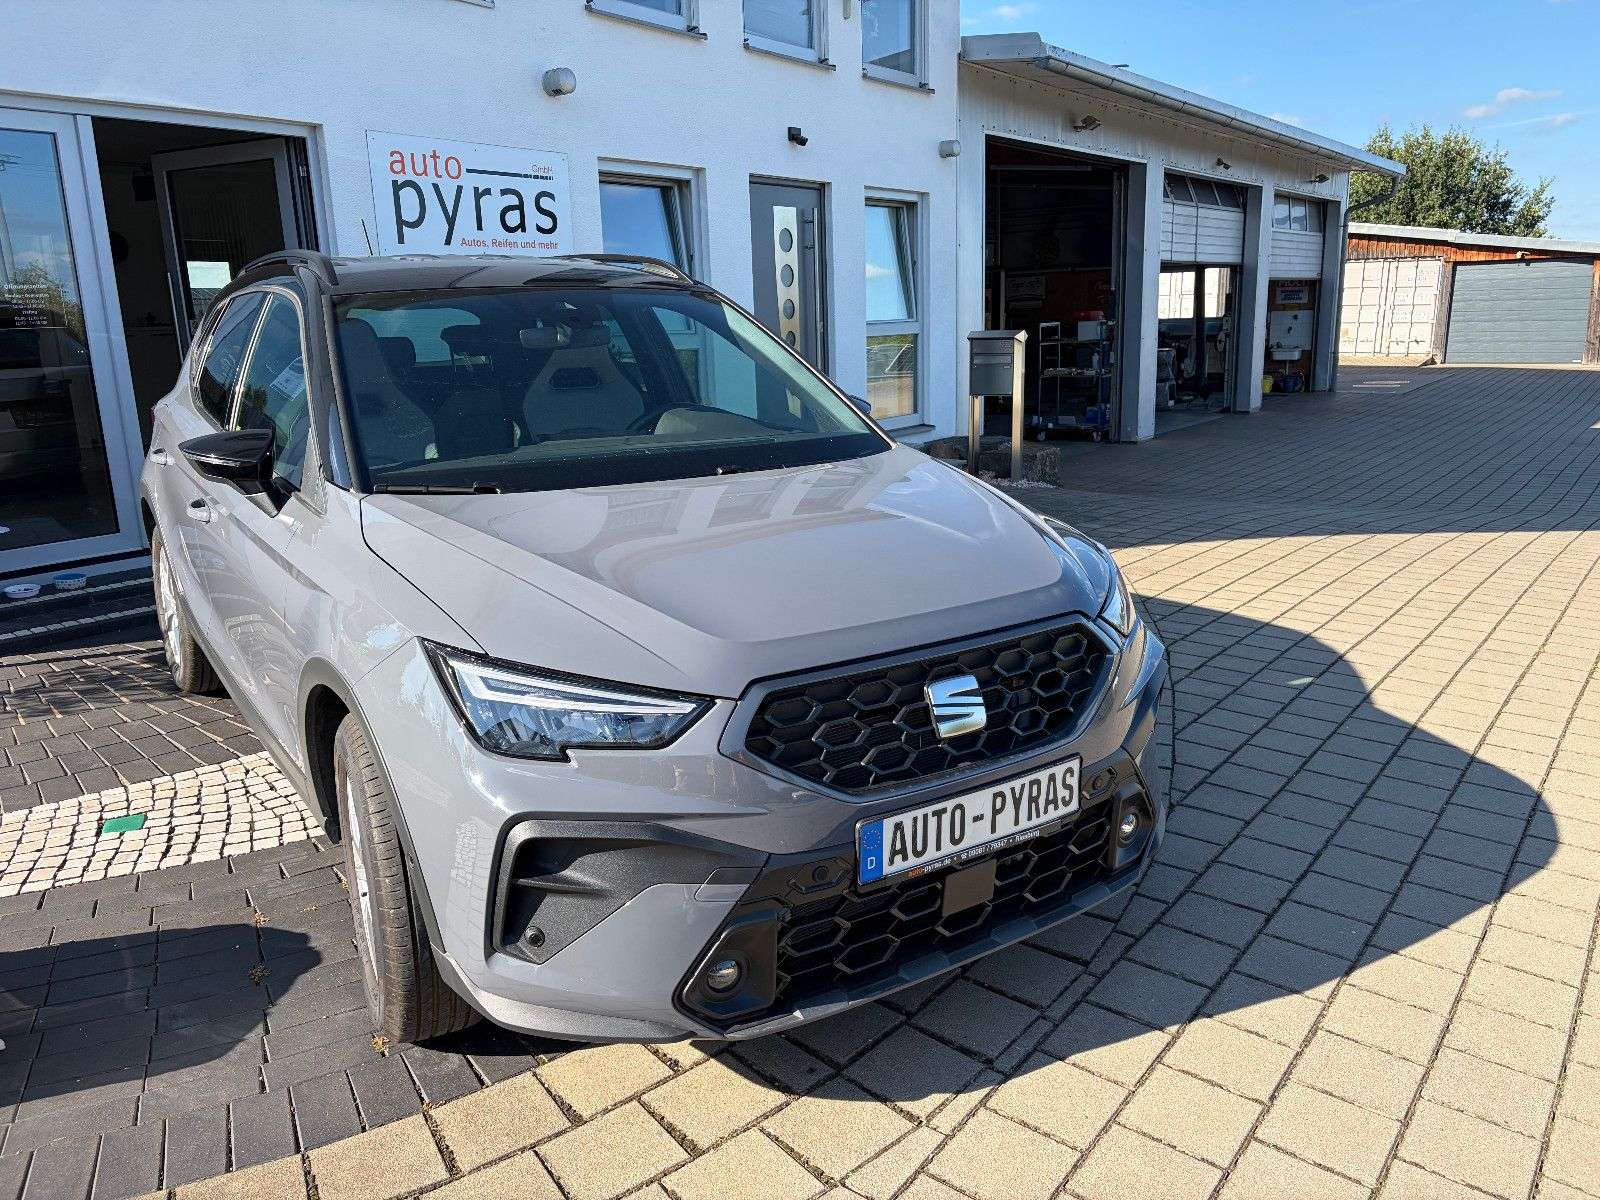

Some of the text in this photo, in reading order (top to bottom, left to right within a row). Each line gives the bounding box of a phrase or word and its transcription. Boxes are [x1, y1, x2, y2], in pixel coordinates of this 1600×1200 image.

[389, 150, 462, 180] auto
[391, 179, 558, 246] pyras
[460, 237, 559, 250] Autos, Reifen und mehr
[867, 856, 876, 870] D
